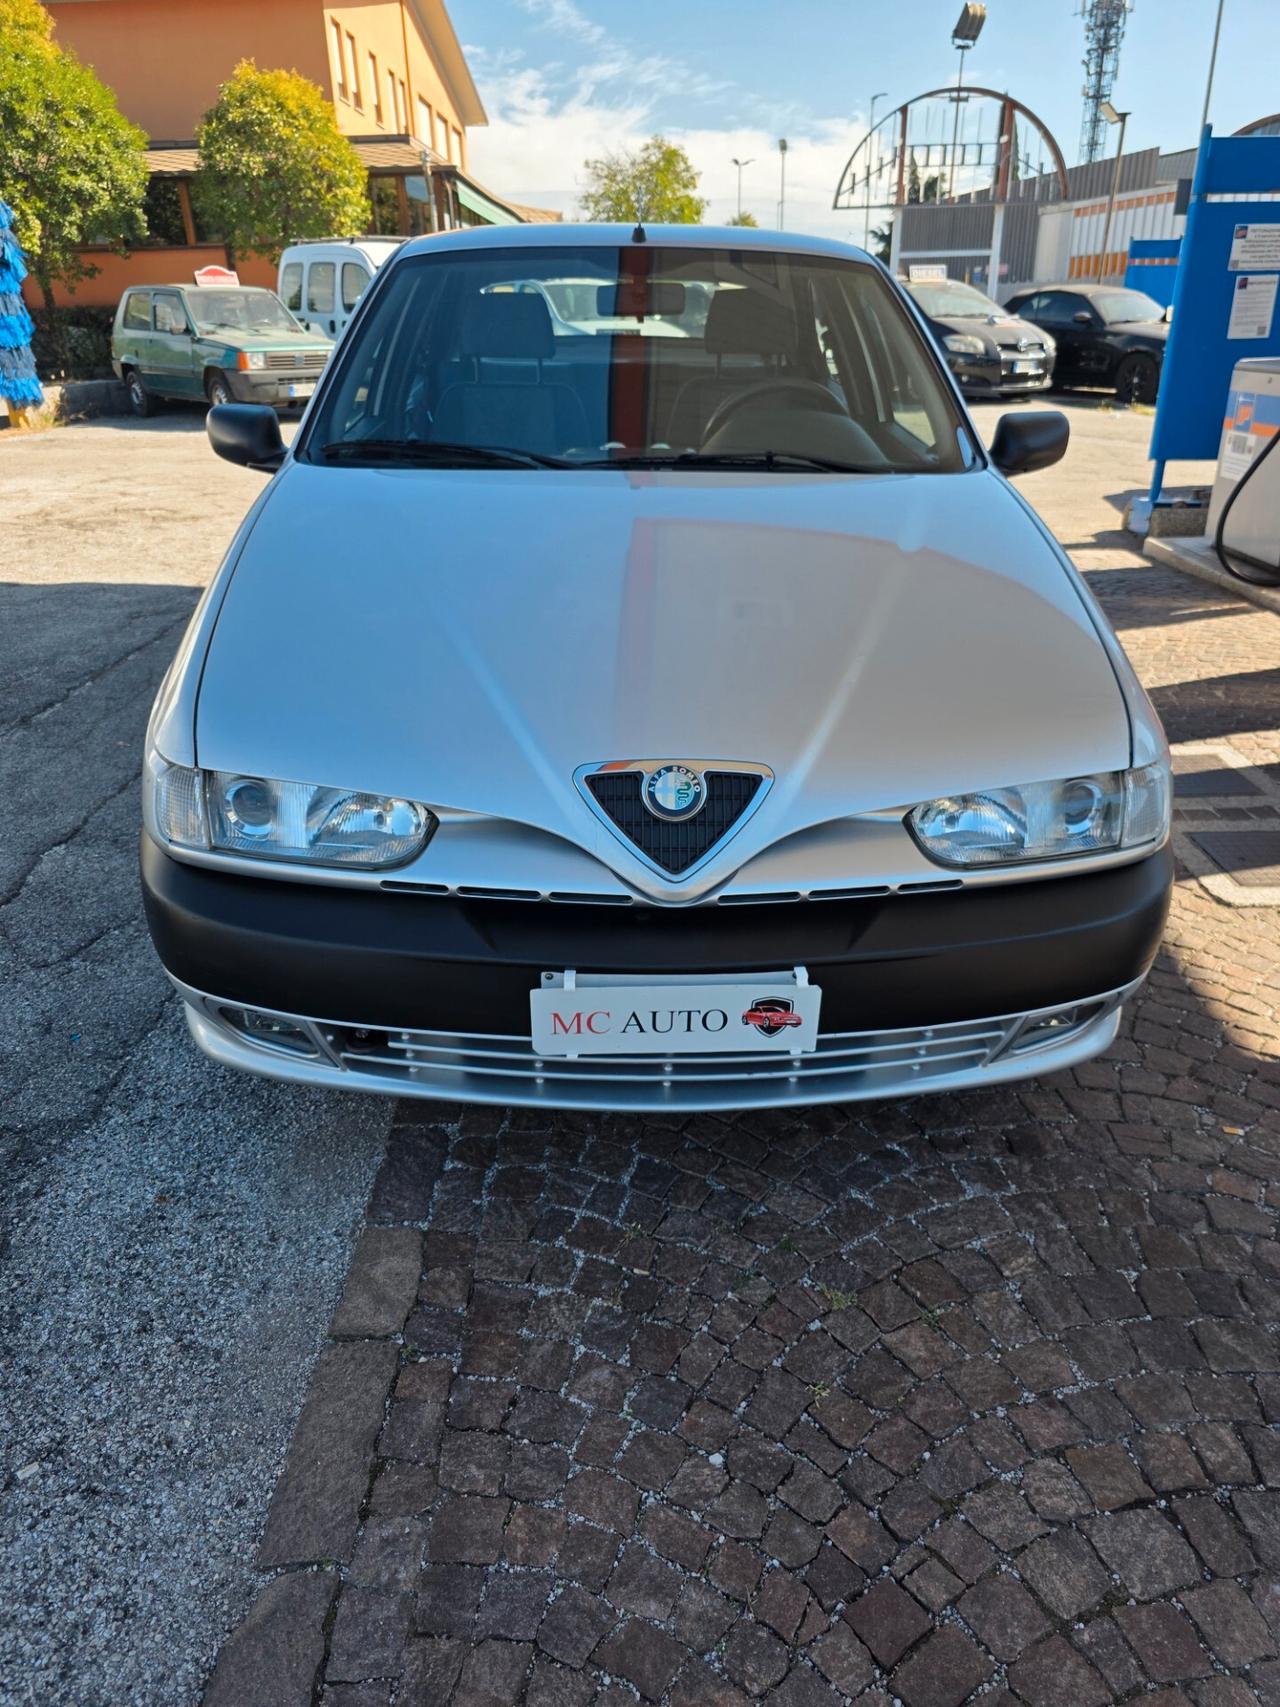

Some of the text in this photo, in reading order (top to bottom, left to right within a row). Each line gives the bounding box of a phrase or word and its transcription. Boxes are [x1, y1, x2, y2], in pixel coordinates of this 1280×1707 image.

[648, 766, 701, 793] ALFA ROMEO
[551, 1008, 728, 1035] MC AUTO
